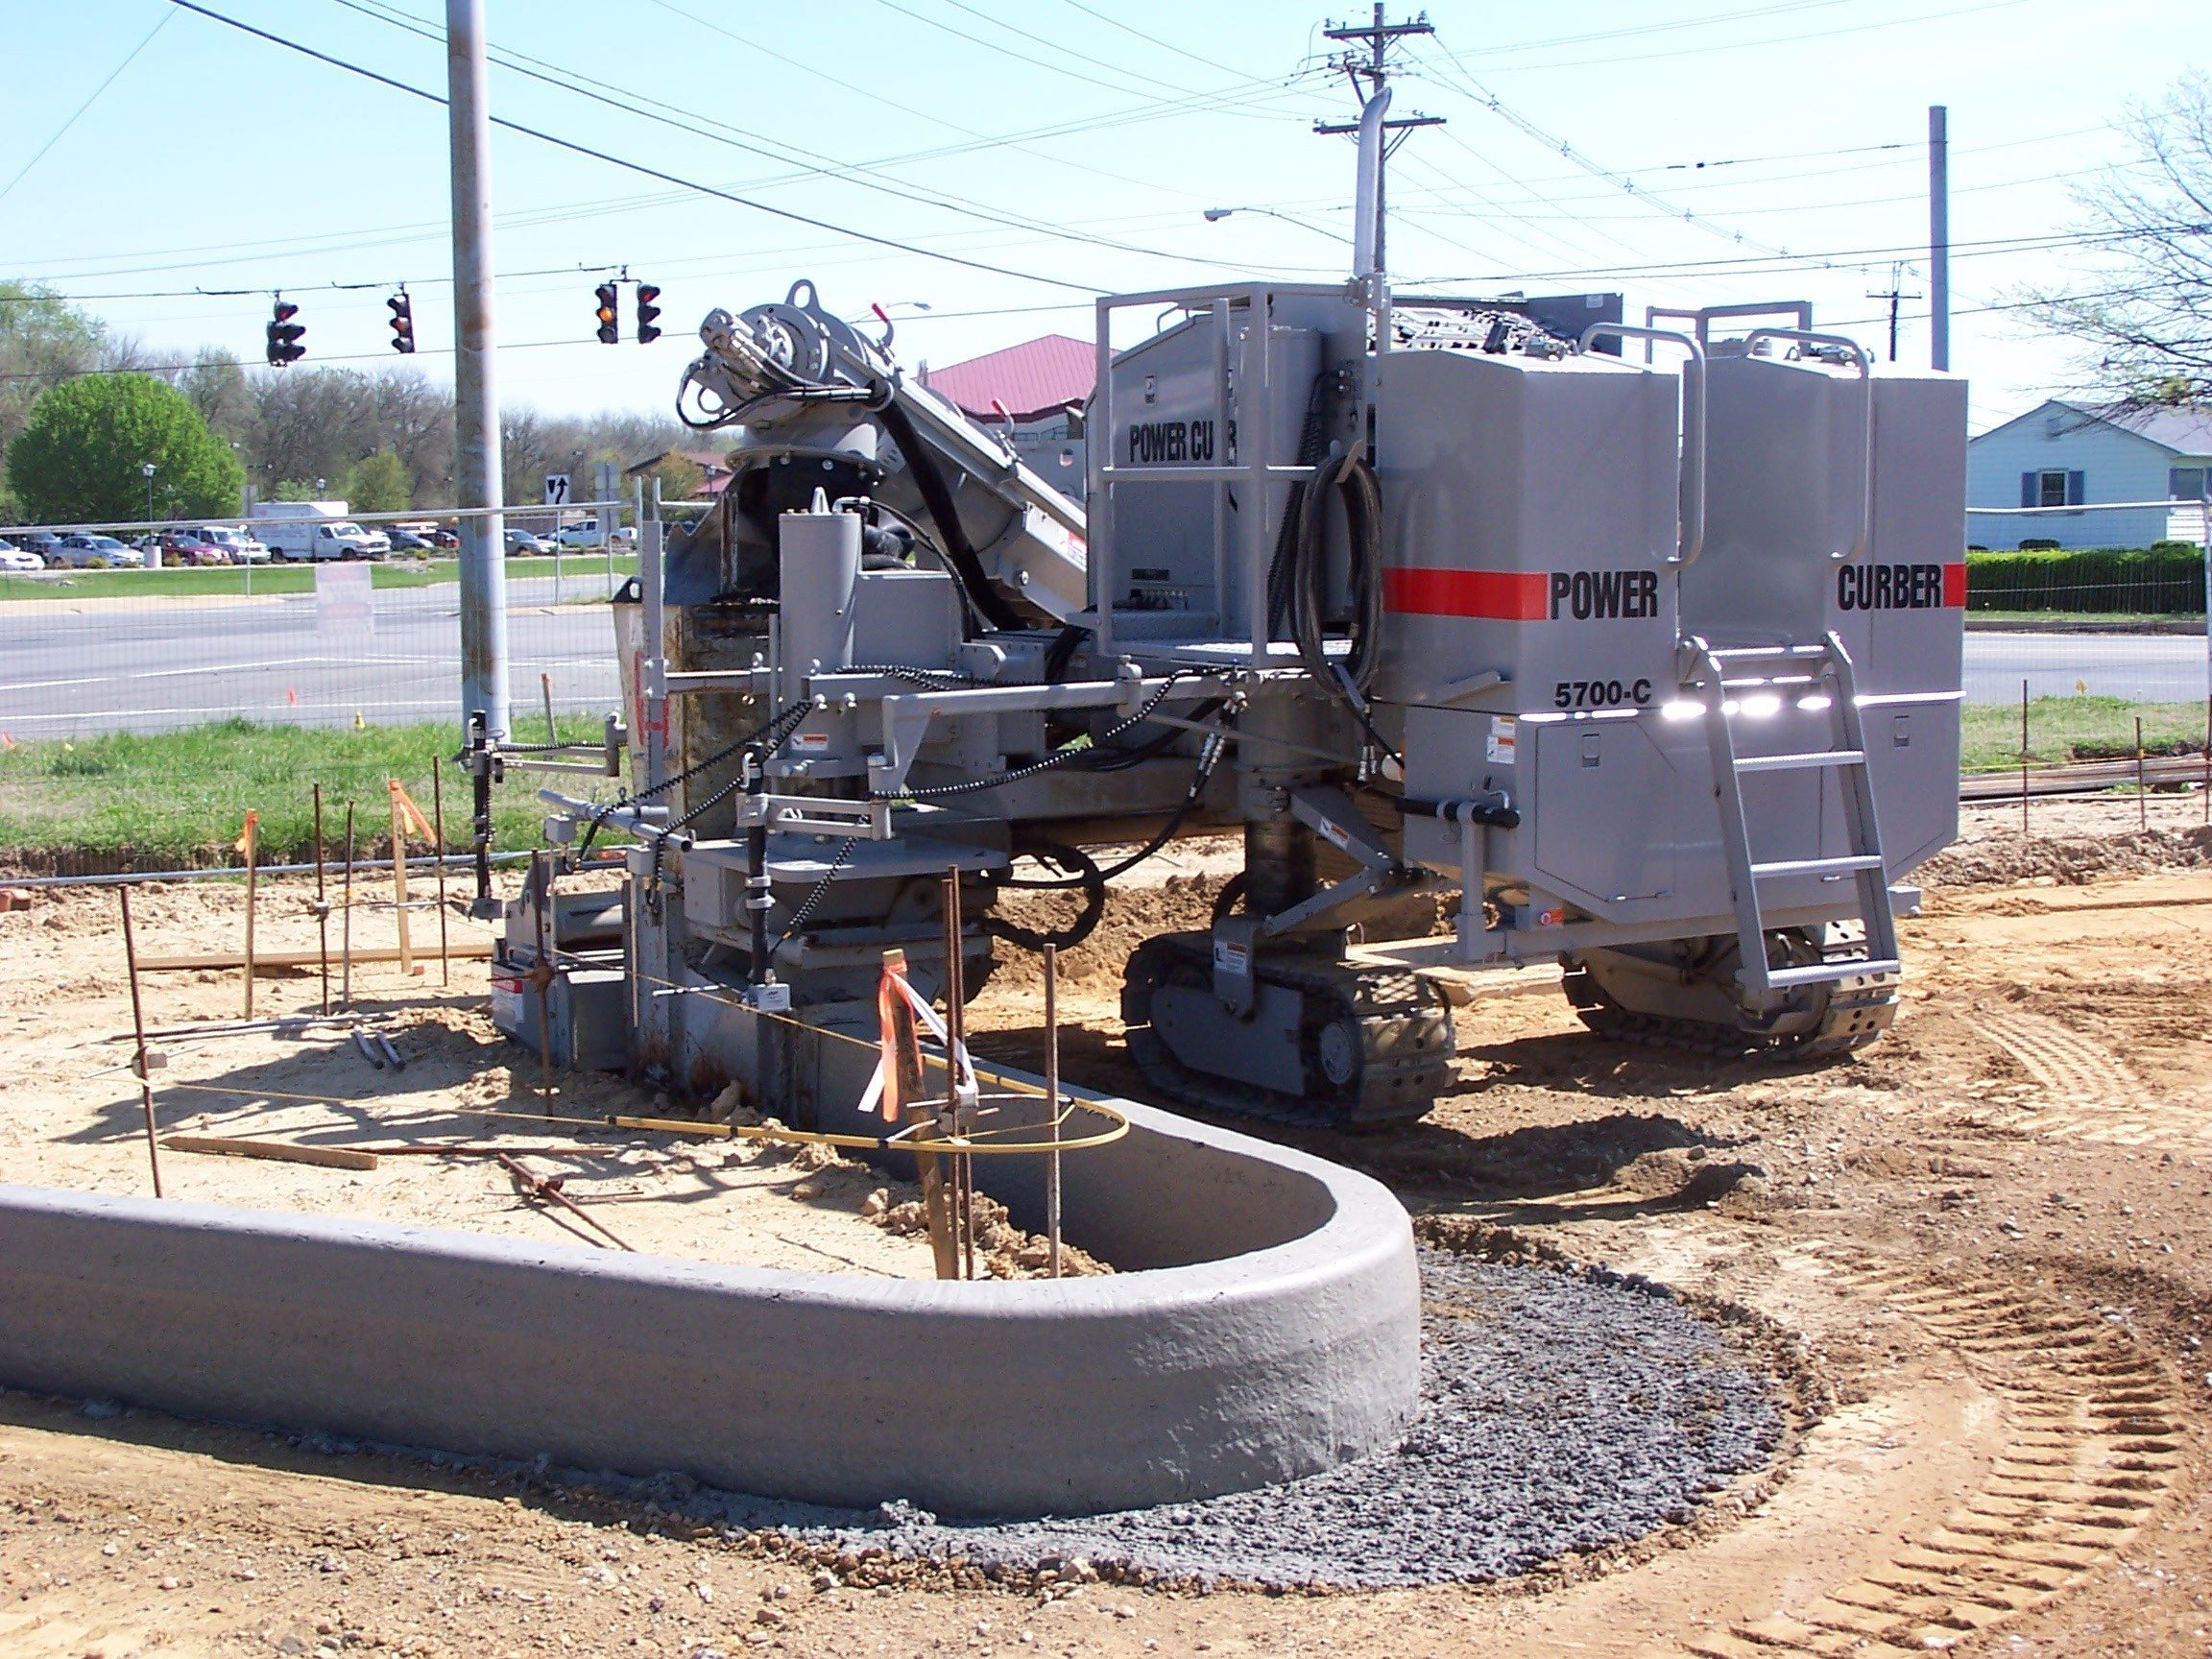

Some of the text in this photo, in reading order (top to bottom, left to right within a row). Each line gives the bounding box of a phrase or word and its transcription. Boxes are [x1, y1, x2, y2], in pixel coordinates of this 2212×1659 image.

[1129, 422, 1187, 463] POWER
[1550, 564, 1942, 620] POWER CURBER
[1554, 678, 1652, 709] 5700-C
